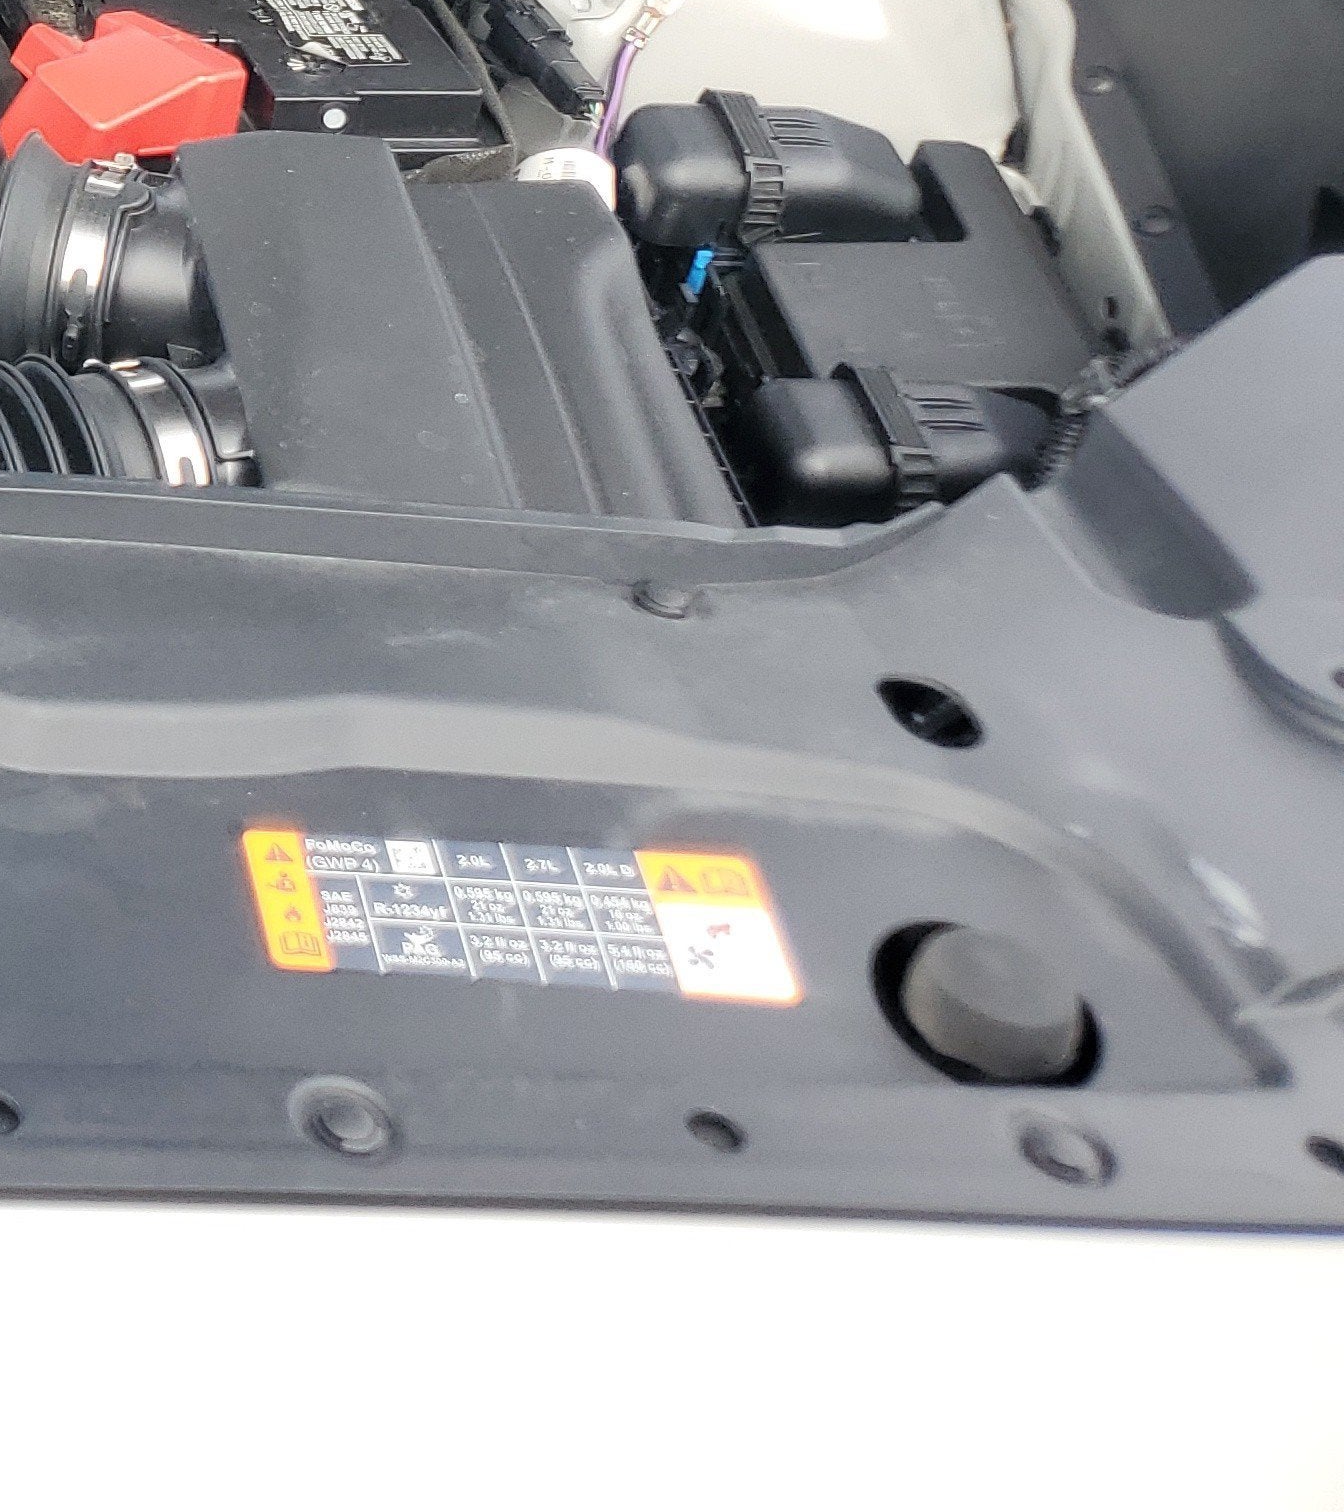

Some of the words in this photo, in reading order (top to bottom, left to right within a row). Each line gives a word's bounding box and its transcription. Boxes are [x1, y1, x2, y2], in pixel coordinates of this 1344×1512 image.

[304, 839, 377, 855] FoMoCo
[523, 858, 560, 872] 2.7L
[320, 890, 354, 903] SAE
[372, 902, 448, 920] R-1234yf
